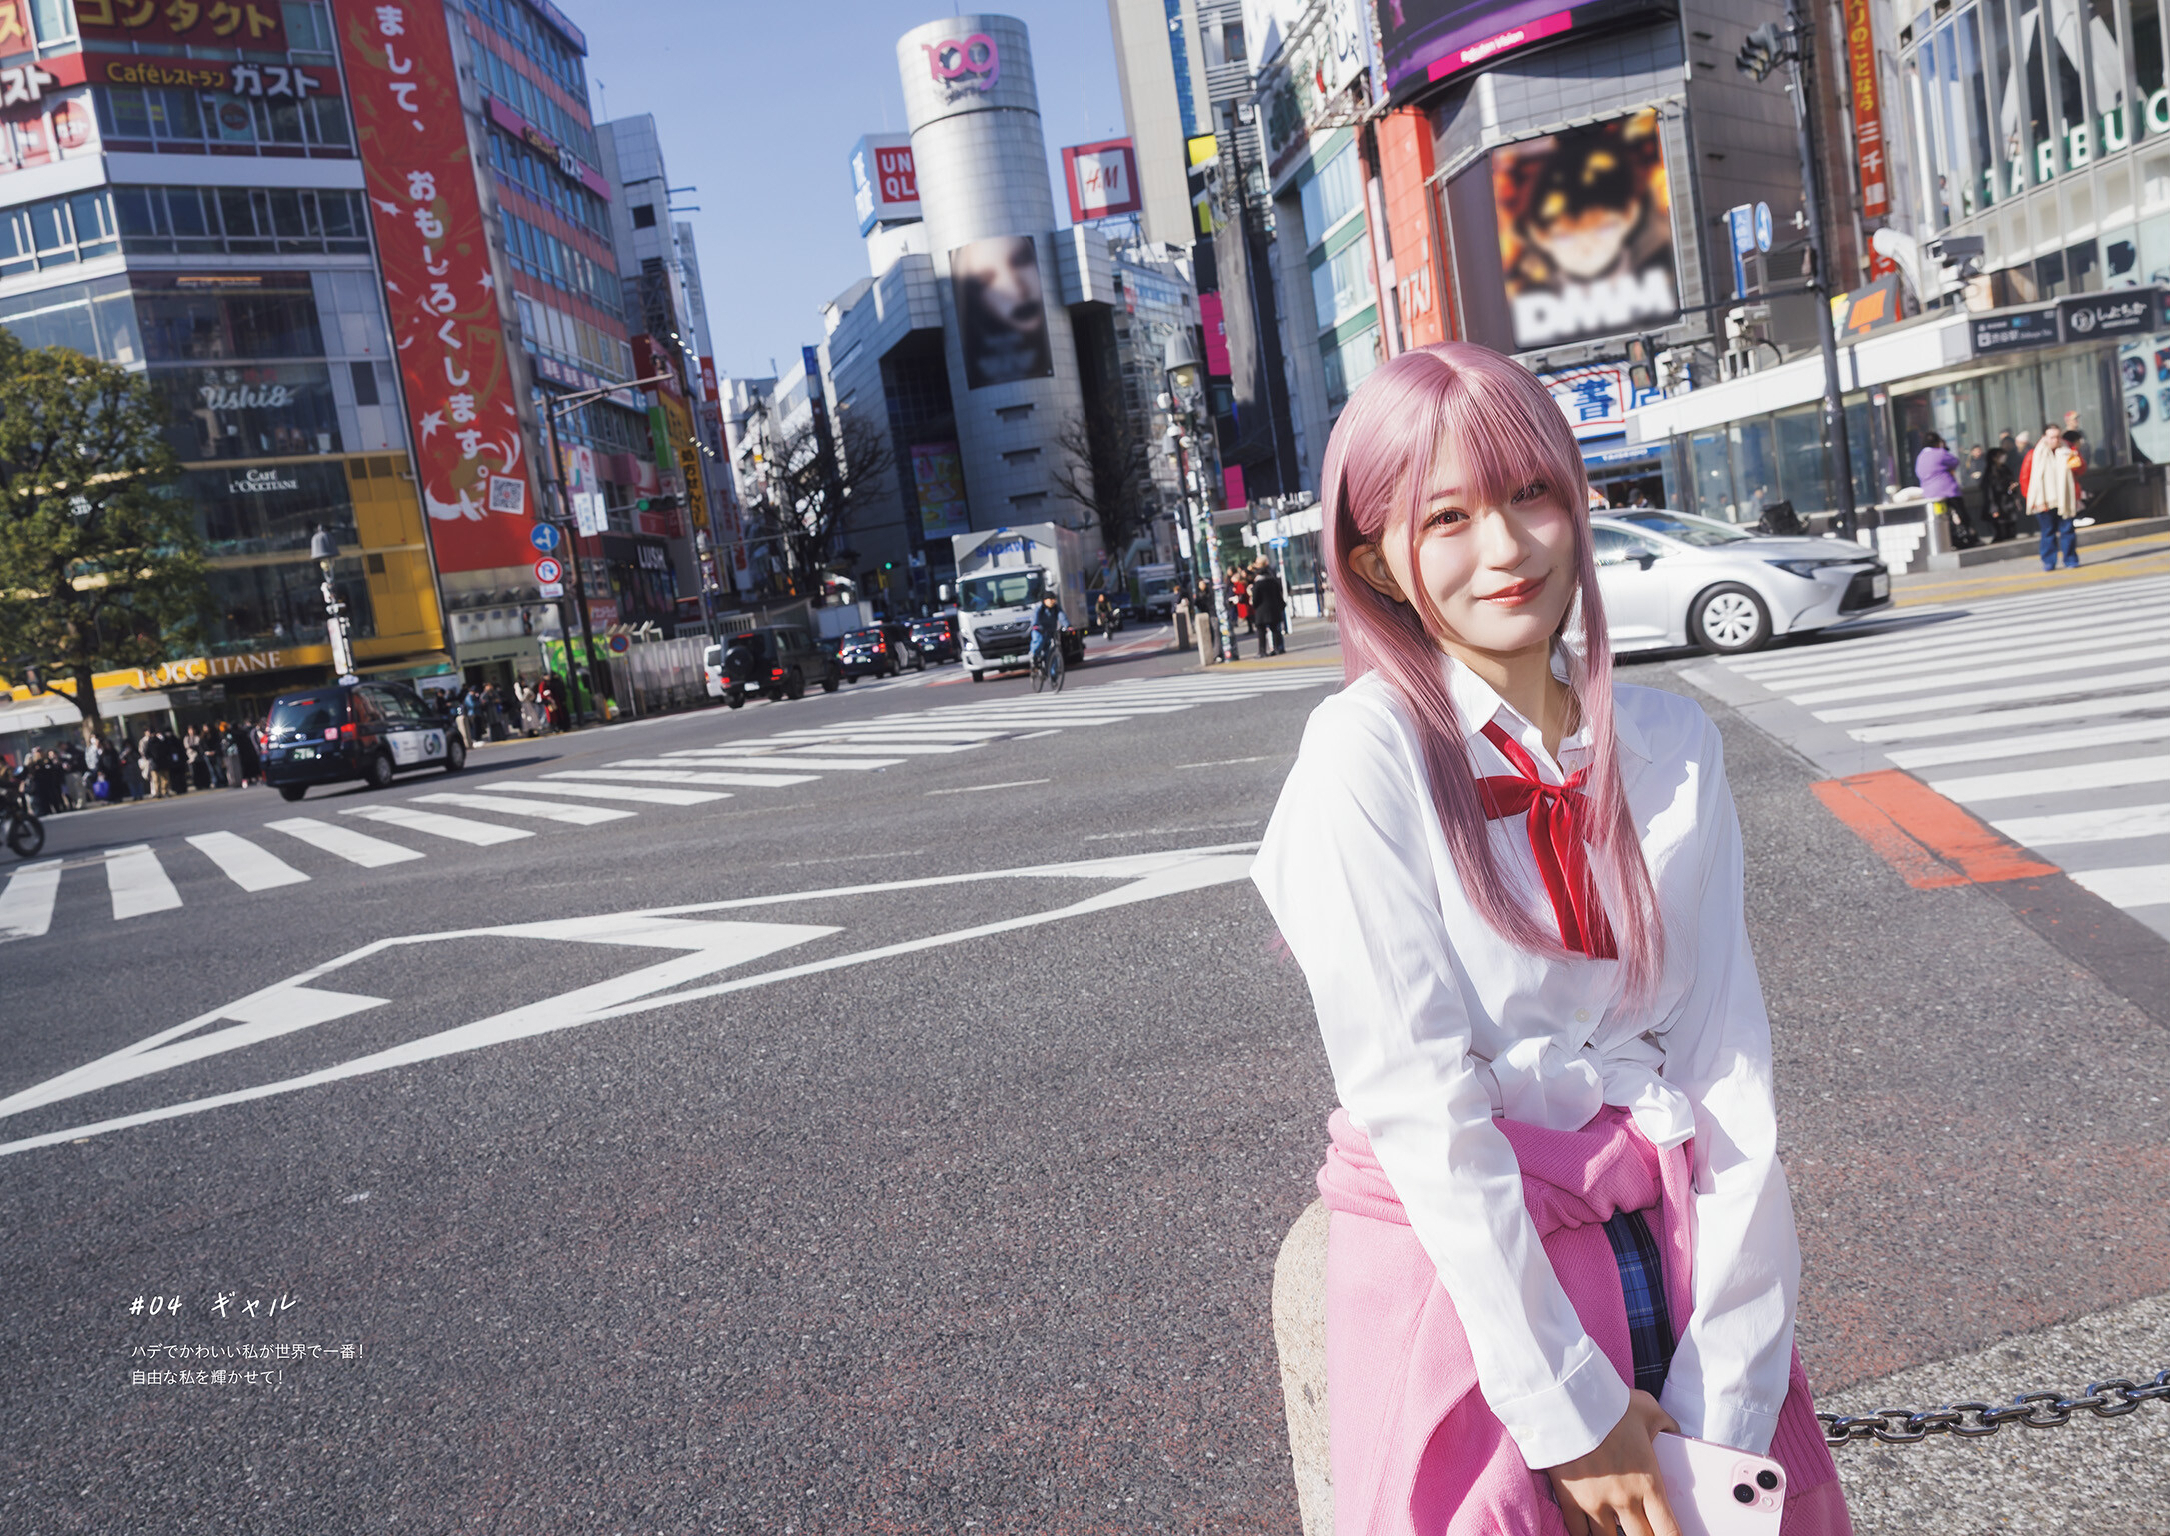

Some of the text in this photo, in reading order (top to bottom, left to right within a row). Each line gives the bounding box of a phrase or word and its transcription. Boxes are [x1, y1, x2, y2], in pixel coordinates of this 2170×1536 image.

[231, 64, 321, 98] ガスト
[921, 33, 1000, 91] 109
[0, 65, 53, 107] スト
[886, 175, 919, 200] QL
